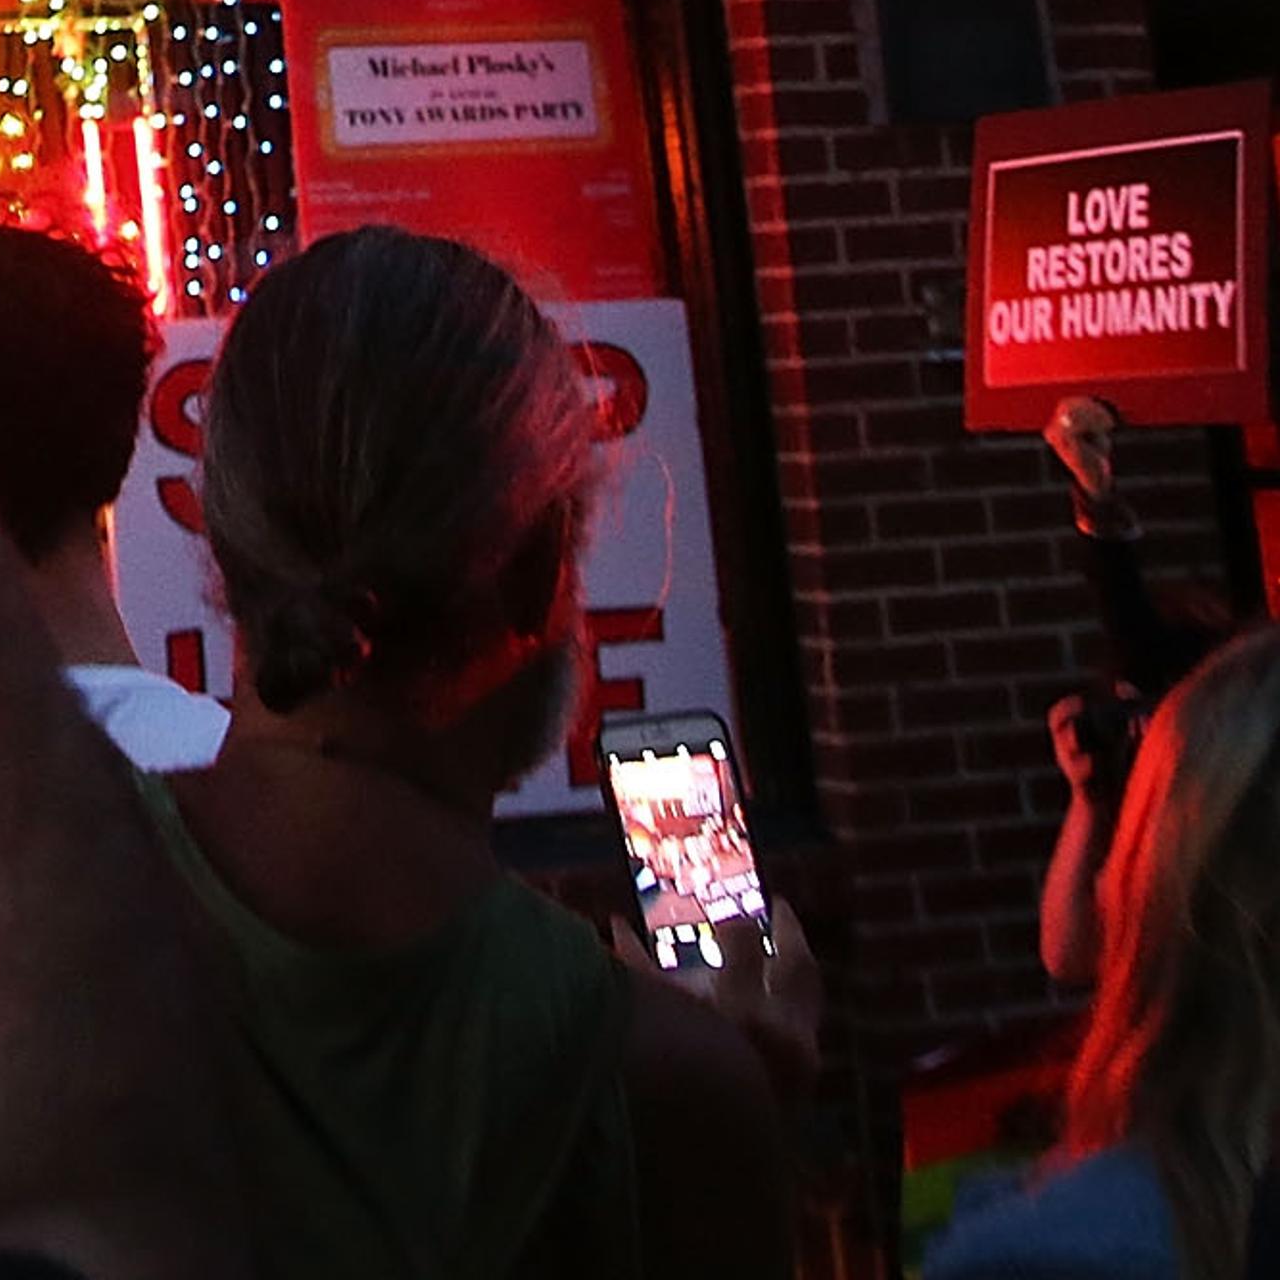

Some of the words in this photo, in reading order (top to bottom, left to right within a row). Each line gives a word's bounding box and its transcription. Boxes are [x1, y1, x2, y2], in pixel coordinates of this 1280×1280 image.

[368, 55, 460, 78] Michael
[344, 107, 406, 127] TONY
[415, 103, 509, 123] AWARDS
[514, 100, 584, 121] PARTY
[1067, 184, 1149, 236] LOVE
[1027, 232, 1192, 291] RESTORES
[990, 297, 1053, 346] OUR
[1060, 280, 1237, 339] HUMANITY
